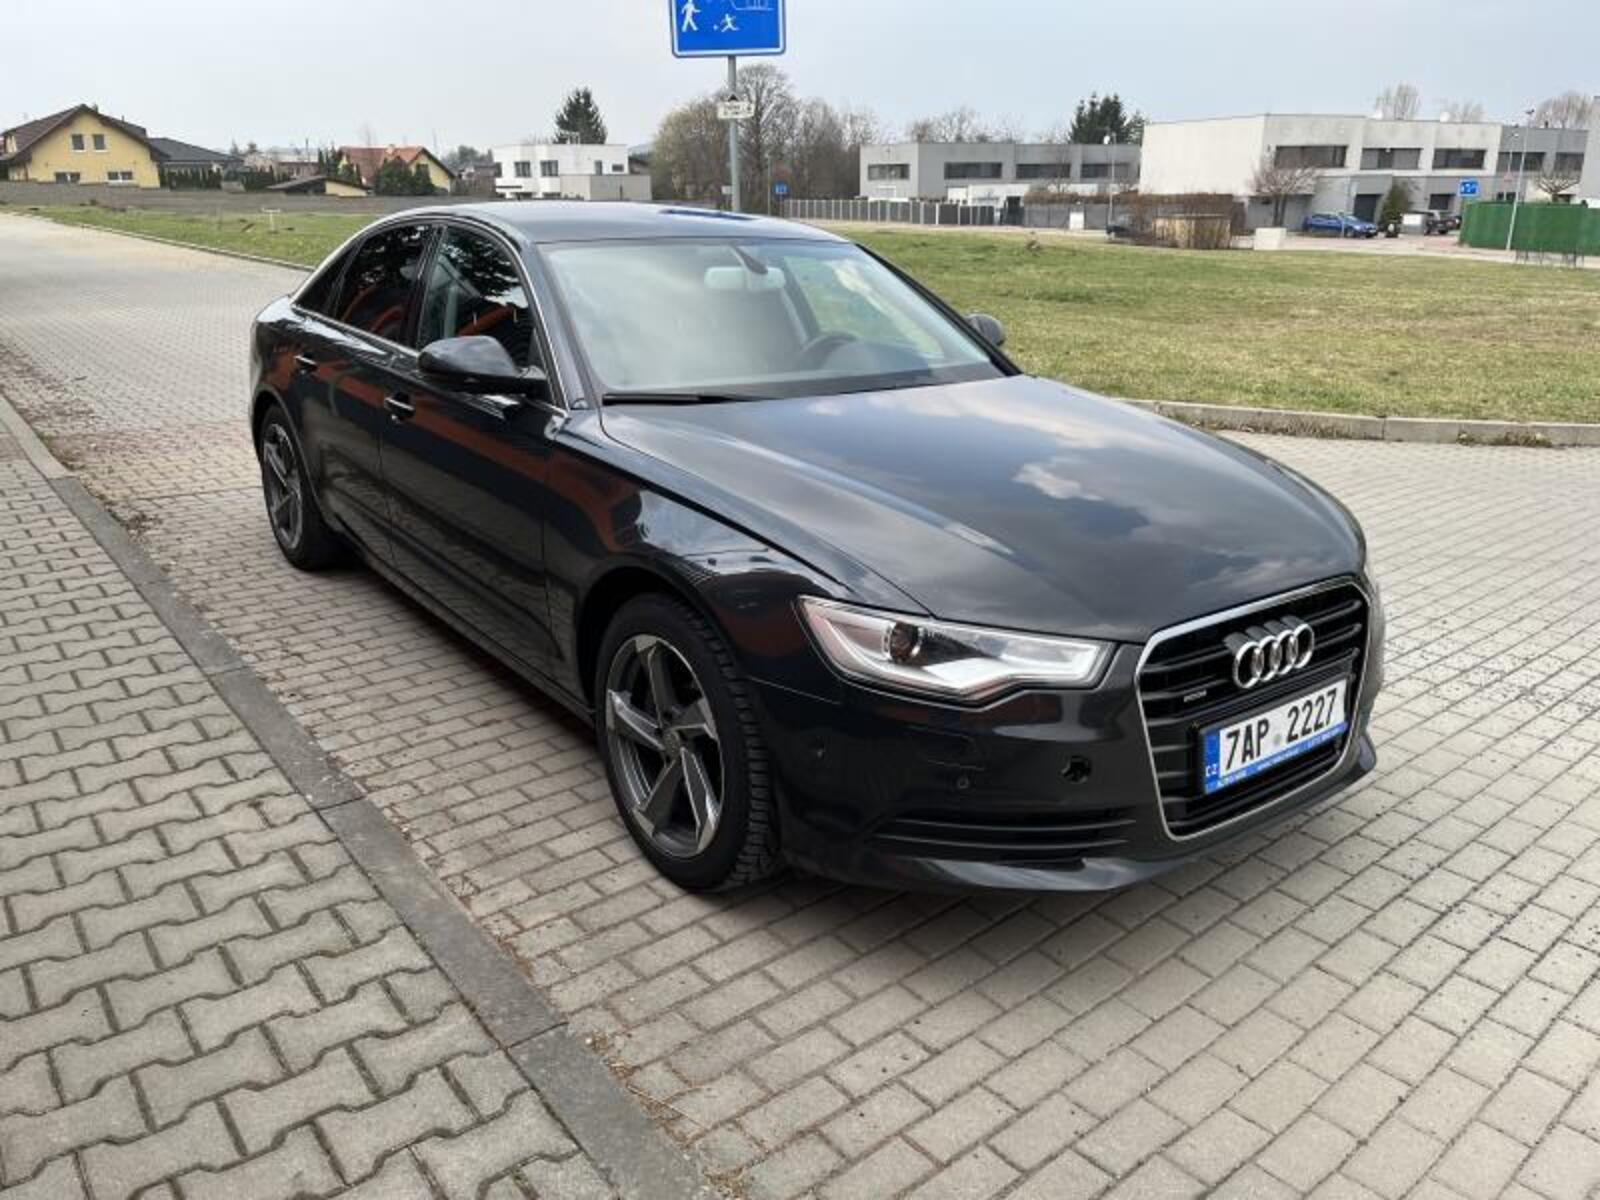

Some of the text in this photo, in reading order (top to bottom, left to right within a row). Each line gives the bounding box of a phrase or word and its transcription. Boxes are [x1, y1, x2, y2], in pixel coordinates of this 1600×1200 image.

[1225, 718, 1270, 771] 7AP
[1286, 687, 1338, 743] 2227
[1205, 763, 1217, 778] CZ
